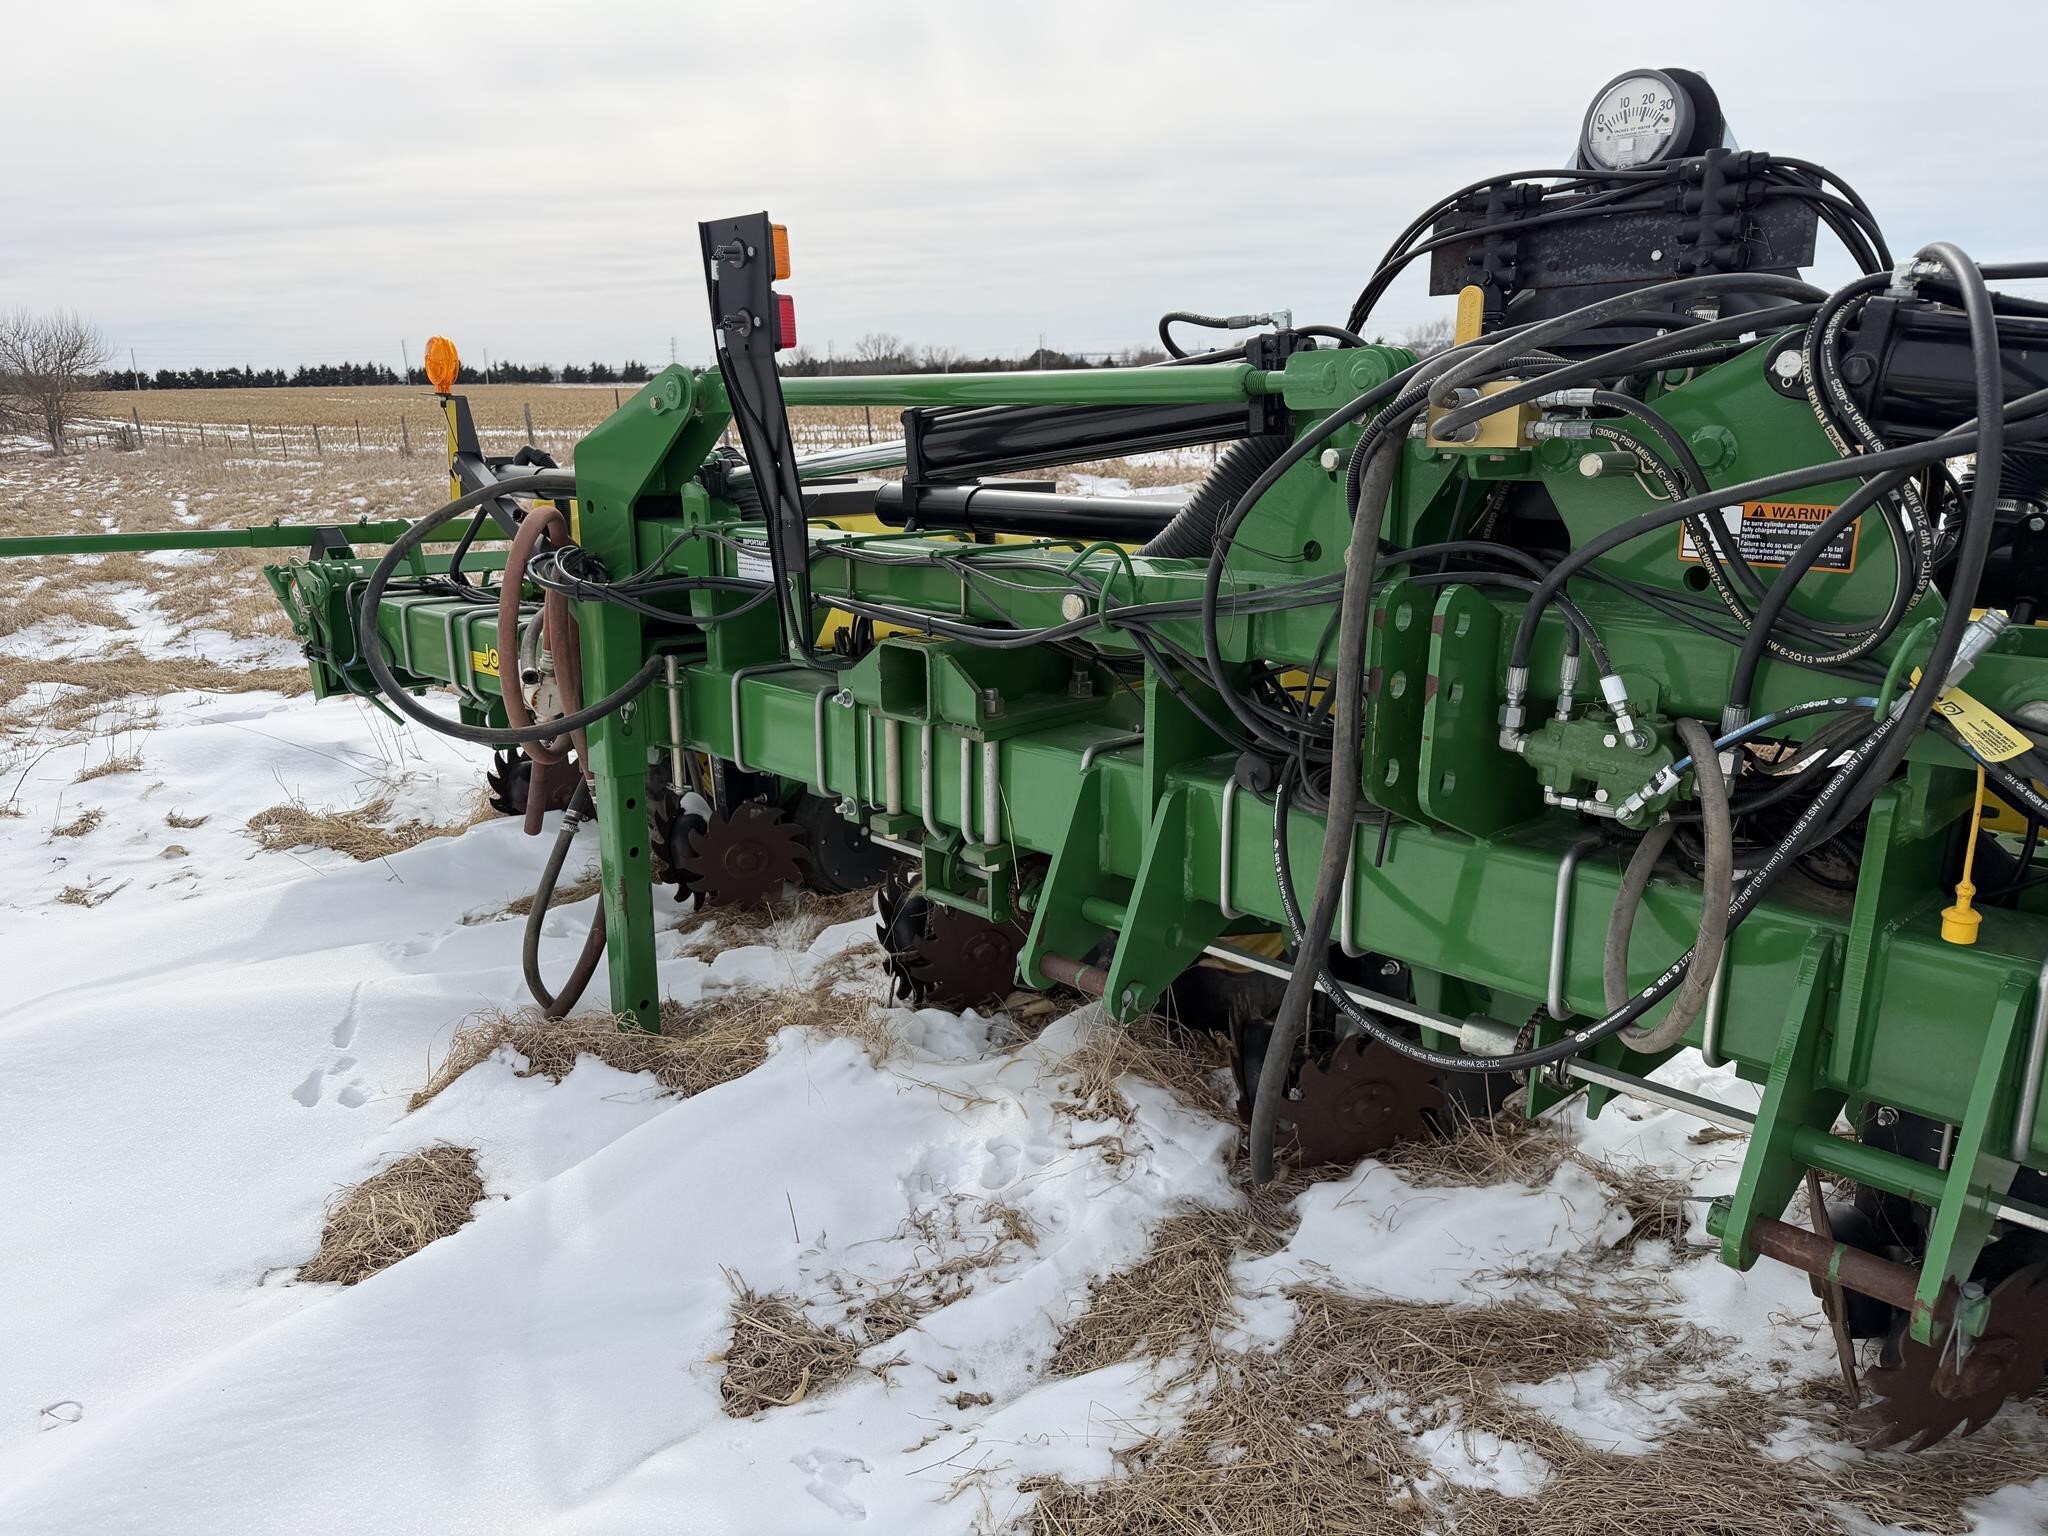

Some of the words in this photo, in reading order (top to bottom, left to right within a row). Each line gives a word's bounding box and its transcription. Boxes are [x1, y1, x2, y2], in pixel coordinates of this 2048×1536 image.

[1597, 113, 1605, 125] 0
[1620, 96, 1630, 108] 10
[1642, 92, 1656, 105] 20
[1659, 98, 1674, 112] 30
[1806, 385, 1829, 427] TOUGH
[1851, 414, 1875, 441] MSHA
[1870, 439, 1885, 453] SI)
[1595, 427, 1619, 440] (3000
[1618, 434, 1637, 450] PSI)
[1635, 446, 1657, 469] MSHA
[1656, 467, 1681, 502] IC-40/26
[1903, 484, 1919, 506] MPa
[1772, 506, 1832, 520] WARNI
[1912, 505, 1928, 527] 21.0
[1920, 529, 1932, 548] WP
[1774, 549, 1797, 557] attempt
[1917, 549, 1932, 590] 451TC-4
[1721, 591, 1734, 605] 6.3
[1729, 604, 1744, 620] mm
[1903, 592, 1922, 616] VER
[482, 642, 499, 670] JO
[1815, 632, 1878, 664] www.parker.com
[1778, 820, 1807, 853] ISO1436
[1804, 803, 1820, 821] 1SN
[1818, 798, 1824, 806] /
[1821, 774, 1845, 800] EN853
[1842, 759, 1858, 776] 1SN
[1856, 752, 1863, 760] /
[1860, 738, 1876, 754] SAE
[1873, 717, 1896, 740] 100R
[2004, 773, 2027, 793] 2G-11C
[2024, 789, 2044, 806] MSHA
[1330, 990, 1342, 1003] 1SN
[1343, 1003, 1361, 1021] EN853
[1359, 1019, 1372, 1031] 1SN
[1374, 1029, 1386, 1041] SAE
[1386, 1037, 1409, 1053] 100R1S
[1408, 1047, 1427, 1060] Flame
[1427, 1053, 1456, 1066] Resistant
[1456, 1060, 1475, 1068] MSHA
[1476, 1059, 1500, 1068] 2G-11C
